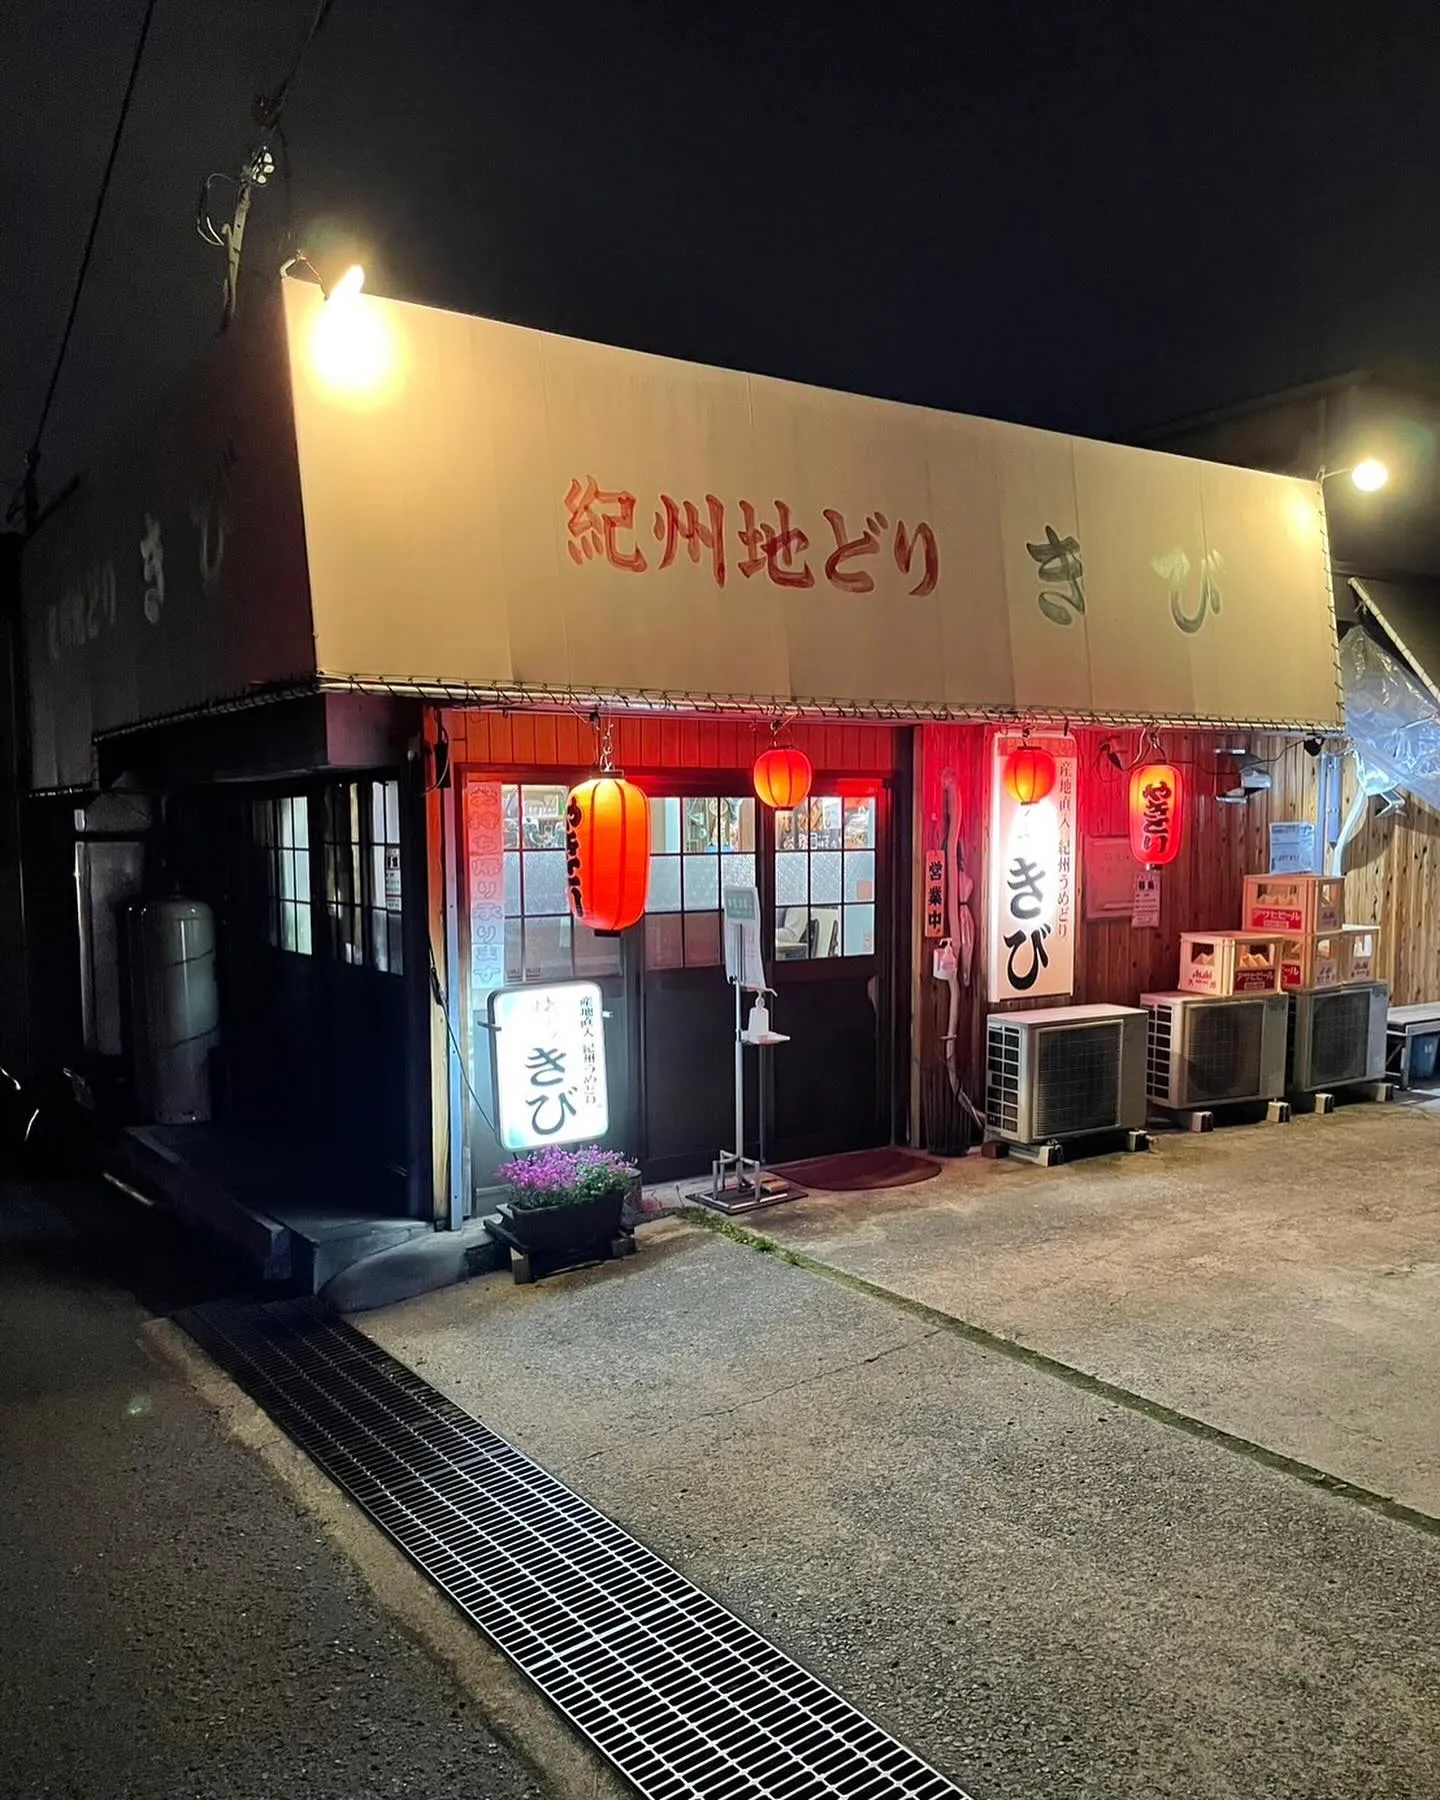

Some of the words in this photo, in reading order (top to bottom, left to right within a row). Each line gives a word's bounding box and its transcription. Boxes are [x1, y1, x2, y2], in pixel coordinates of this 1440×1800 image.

[562, 475, 940, 597] 紀州地どり
[1142, 781, 1172, 854] やきとり
[928, 862, 943, 934] 営業中
[1003, 857, 1052, 992] きび
[524, 1046, 579, 1136] きび
